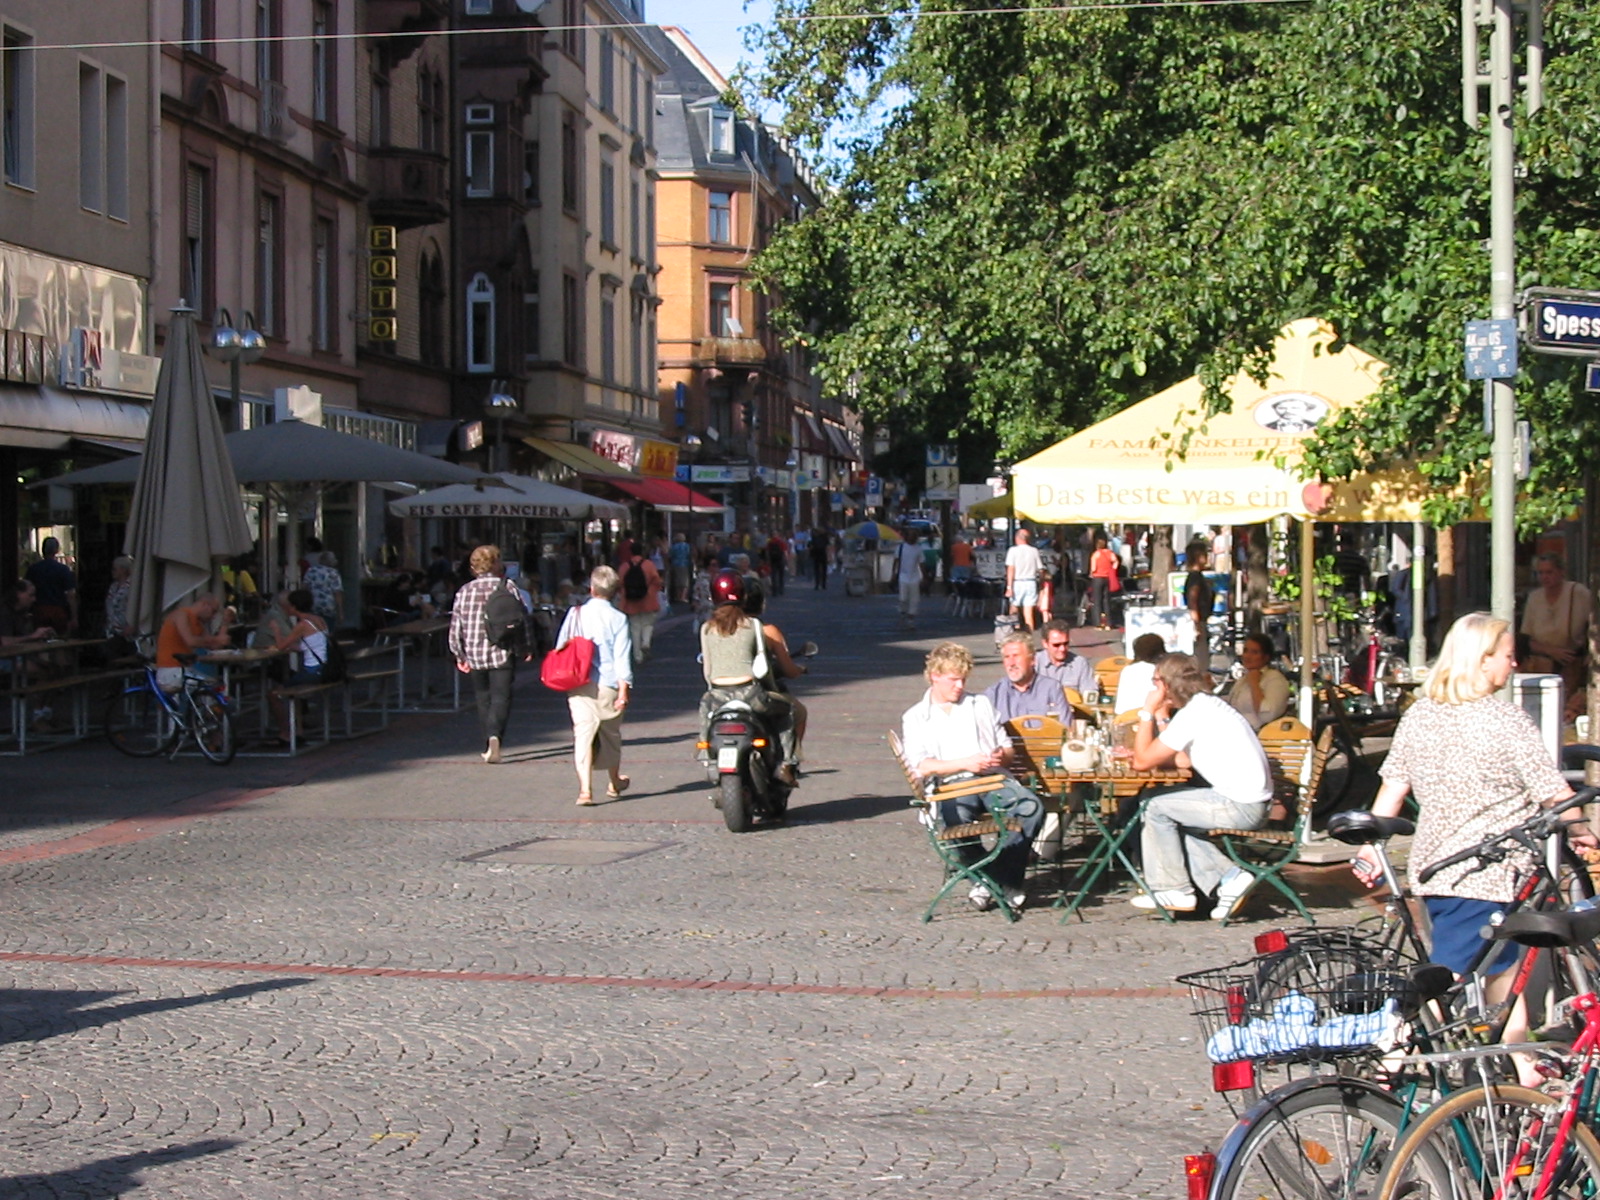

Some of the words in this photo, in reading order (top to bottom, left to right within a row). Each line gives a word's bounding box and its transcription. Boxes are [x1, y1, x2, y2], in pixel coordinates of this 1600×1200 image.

[371, 228, 391, 338] FOTO
[1542, 305, 1600, 340] Spess
[409, 505, 435, 517] EIS
[441, 504, 483, 516] CAFE
[489, 504, 571, 517] PANCIERA
[1035, 484, 1084, 507] Das
[1097, 483, 1171, 505] Beste
[1182, 488, 1235, 507] was
[1247, 484, 1290, 508] ein
